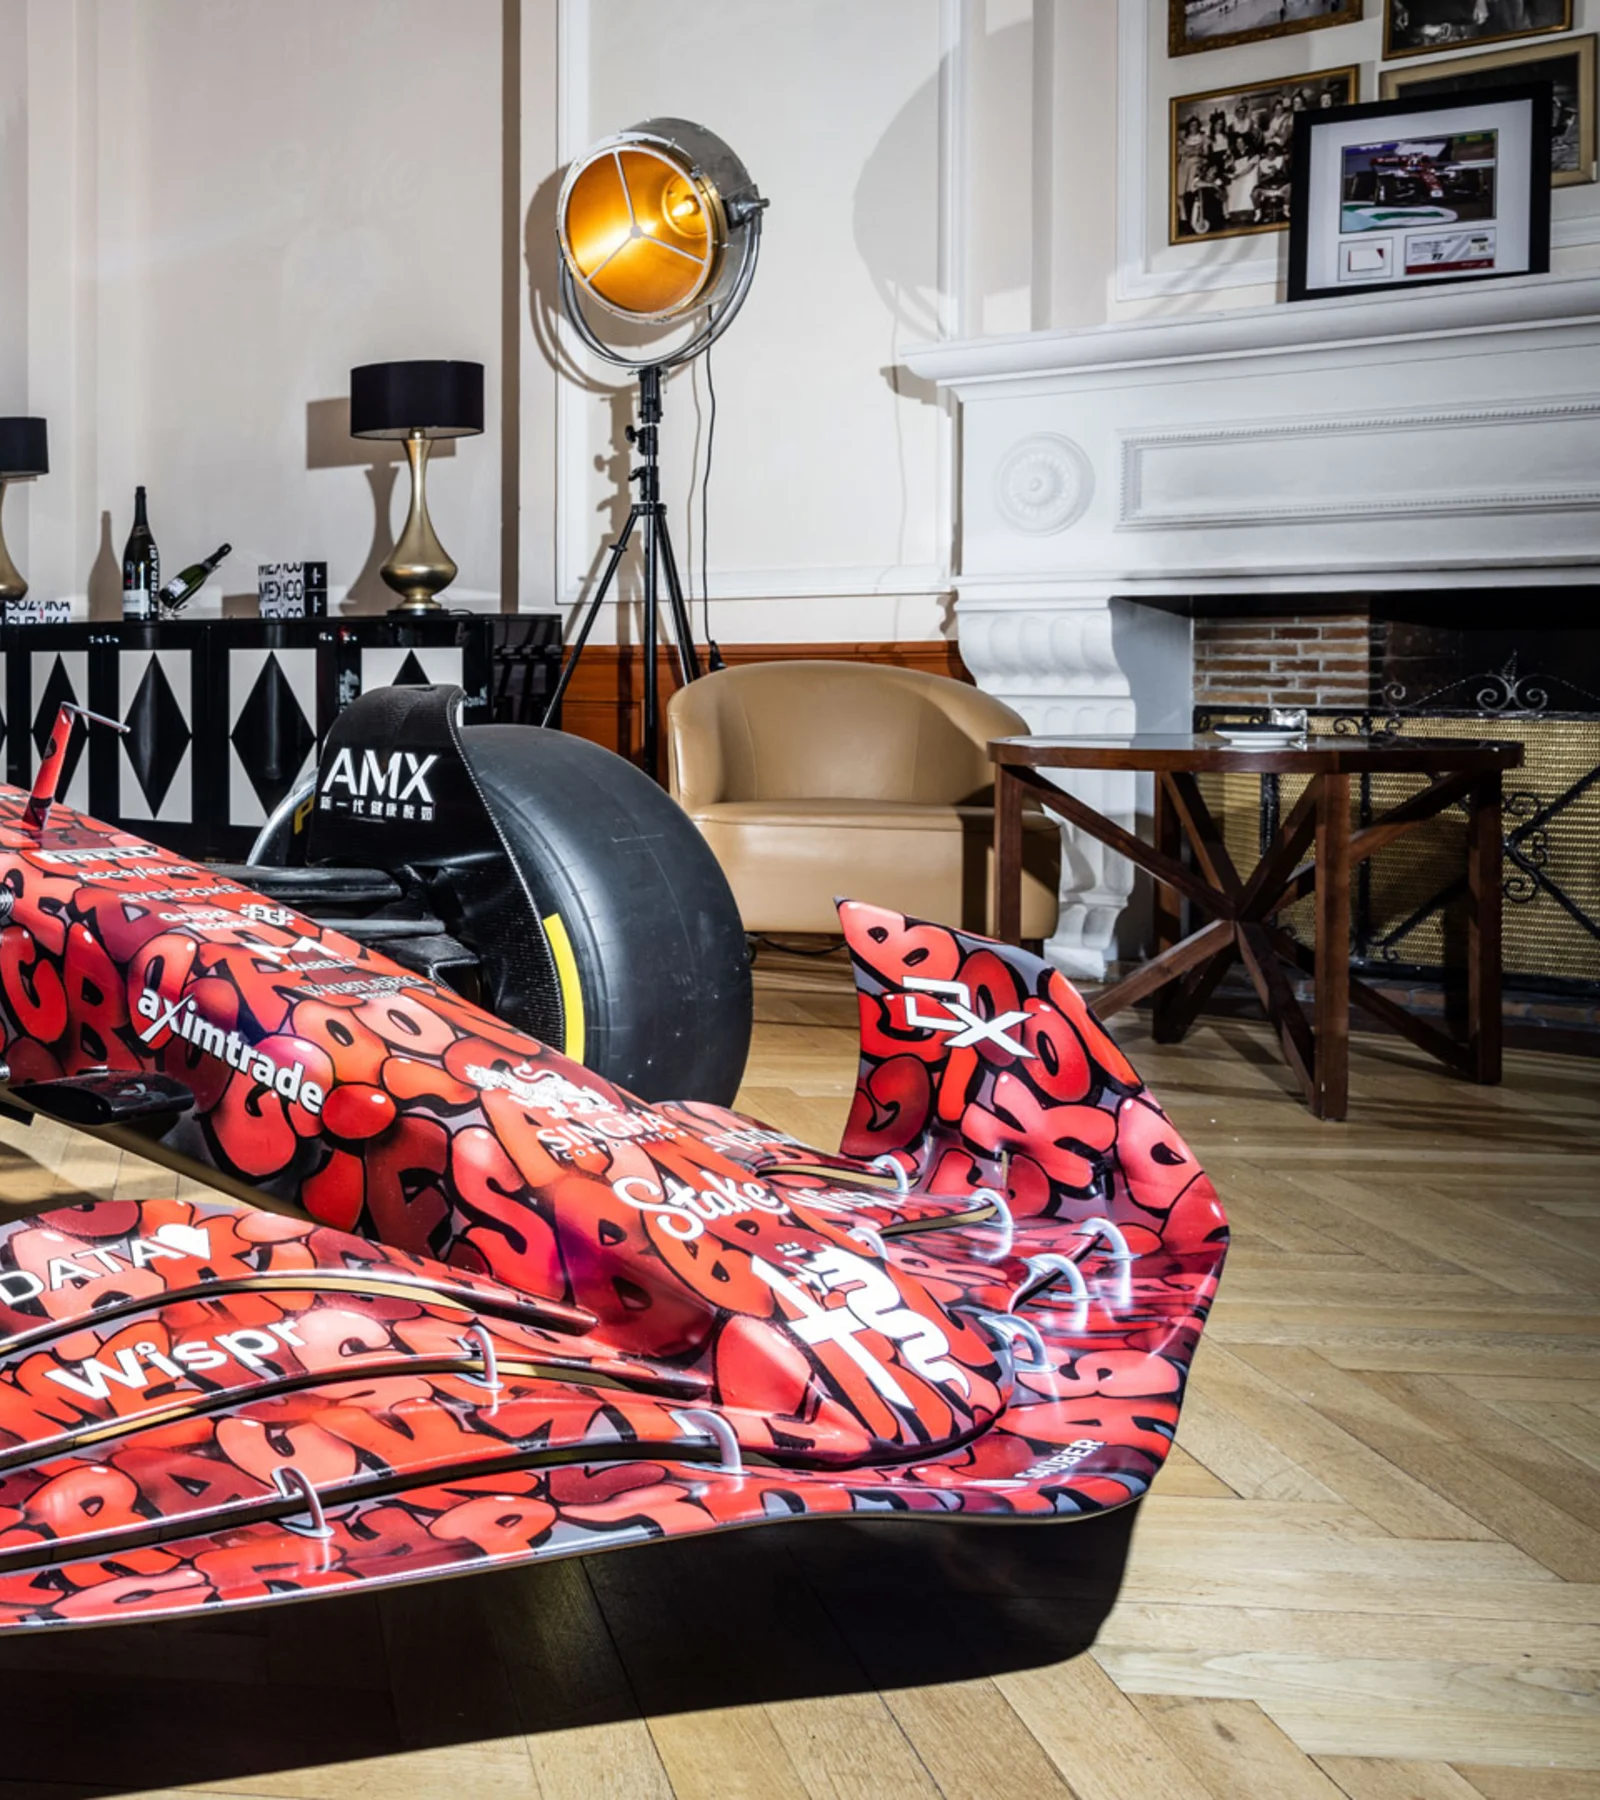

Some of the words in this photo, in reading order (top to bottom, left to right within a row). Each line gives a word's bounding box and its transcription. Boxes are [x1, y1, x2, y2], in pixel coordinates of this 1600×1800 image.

[320, 747, 440, 803] AMX
[137, 986, 326, 1115] aximtrade
[535, 1111, 679, 1152] SINGHA
[612, 1175, 792, 1241] Stake
[44, 1315, 306, 1401] Wispr
